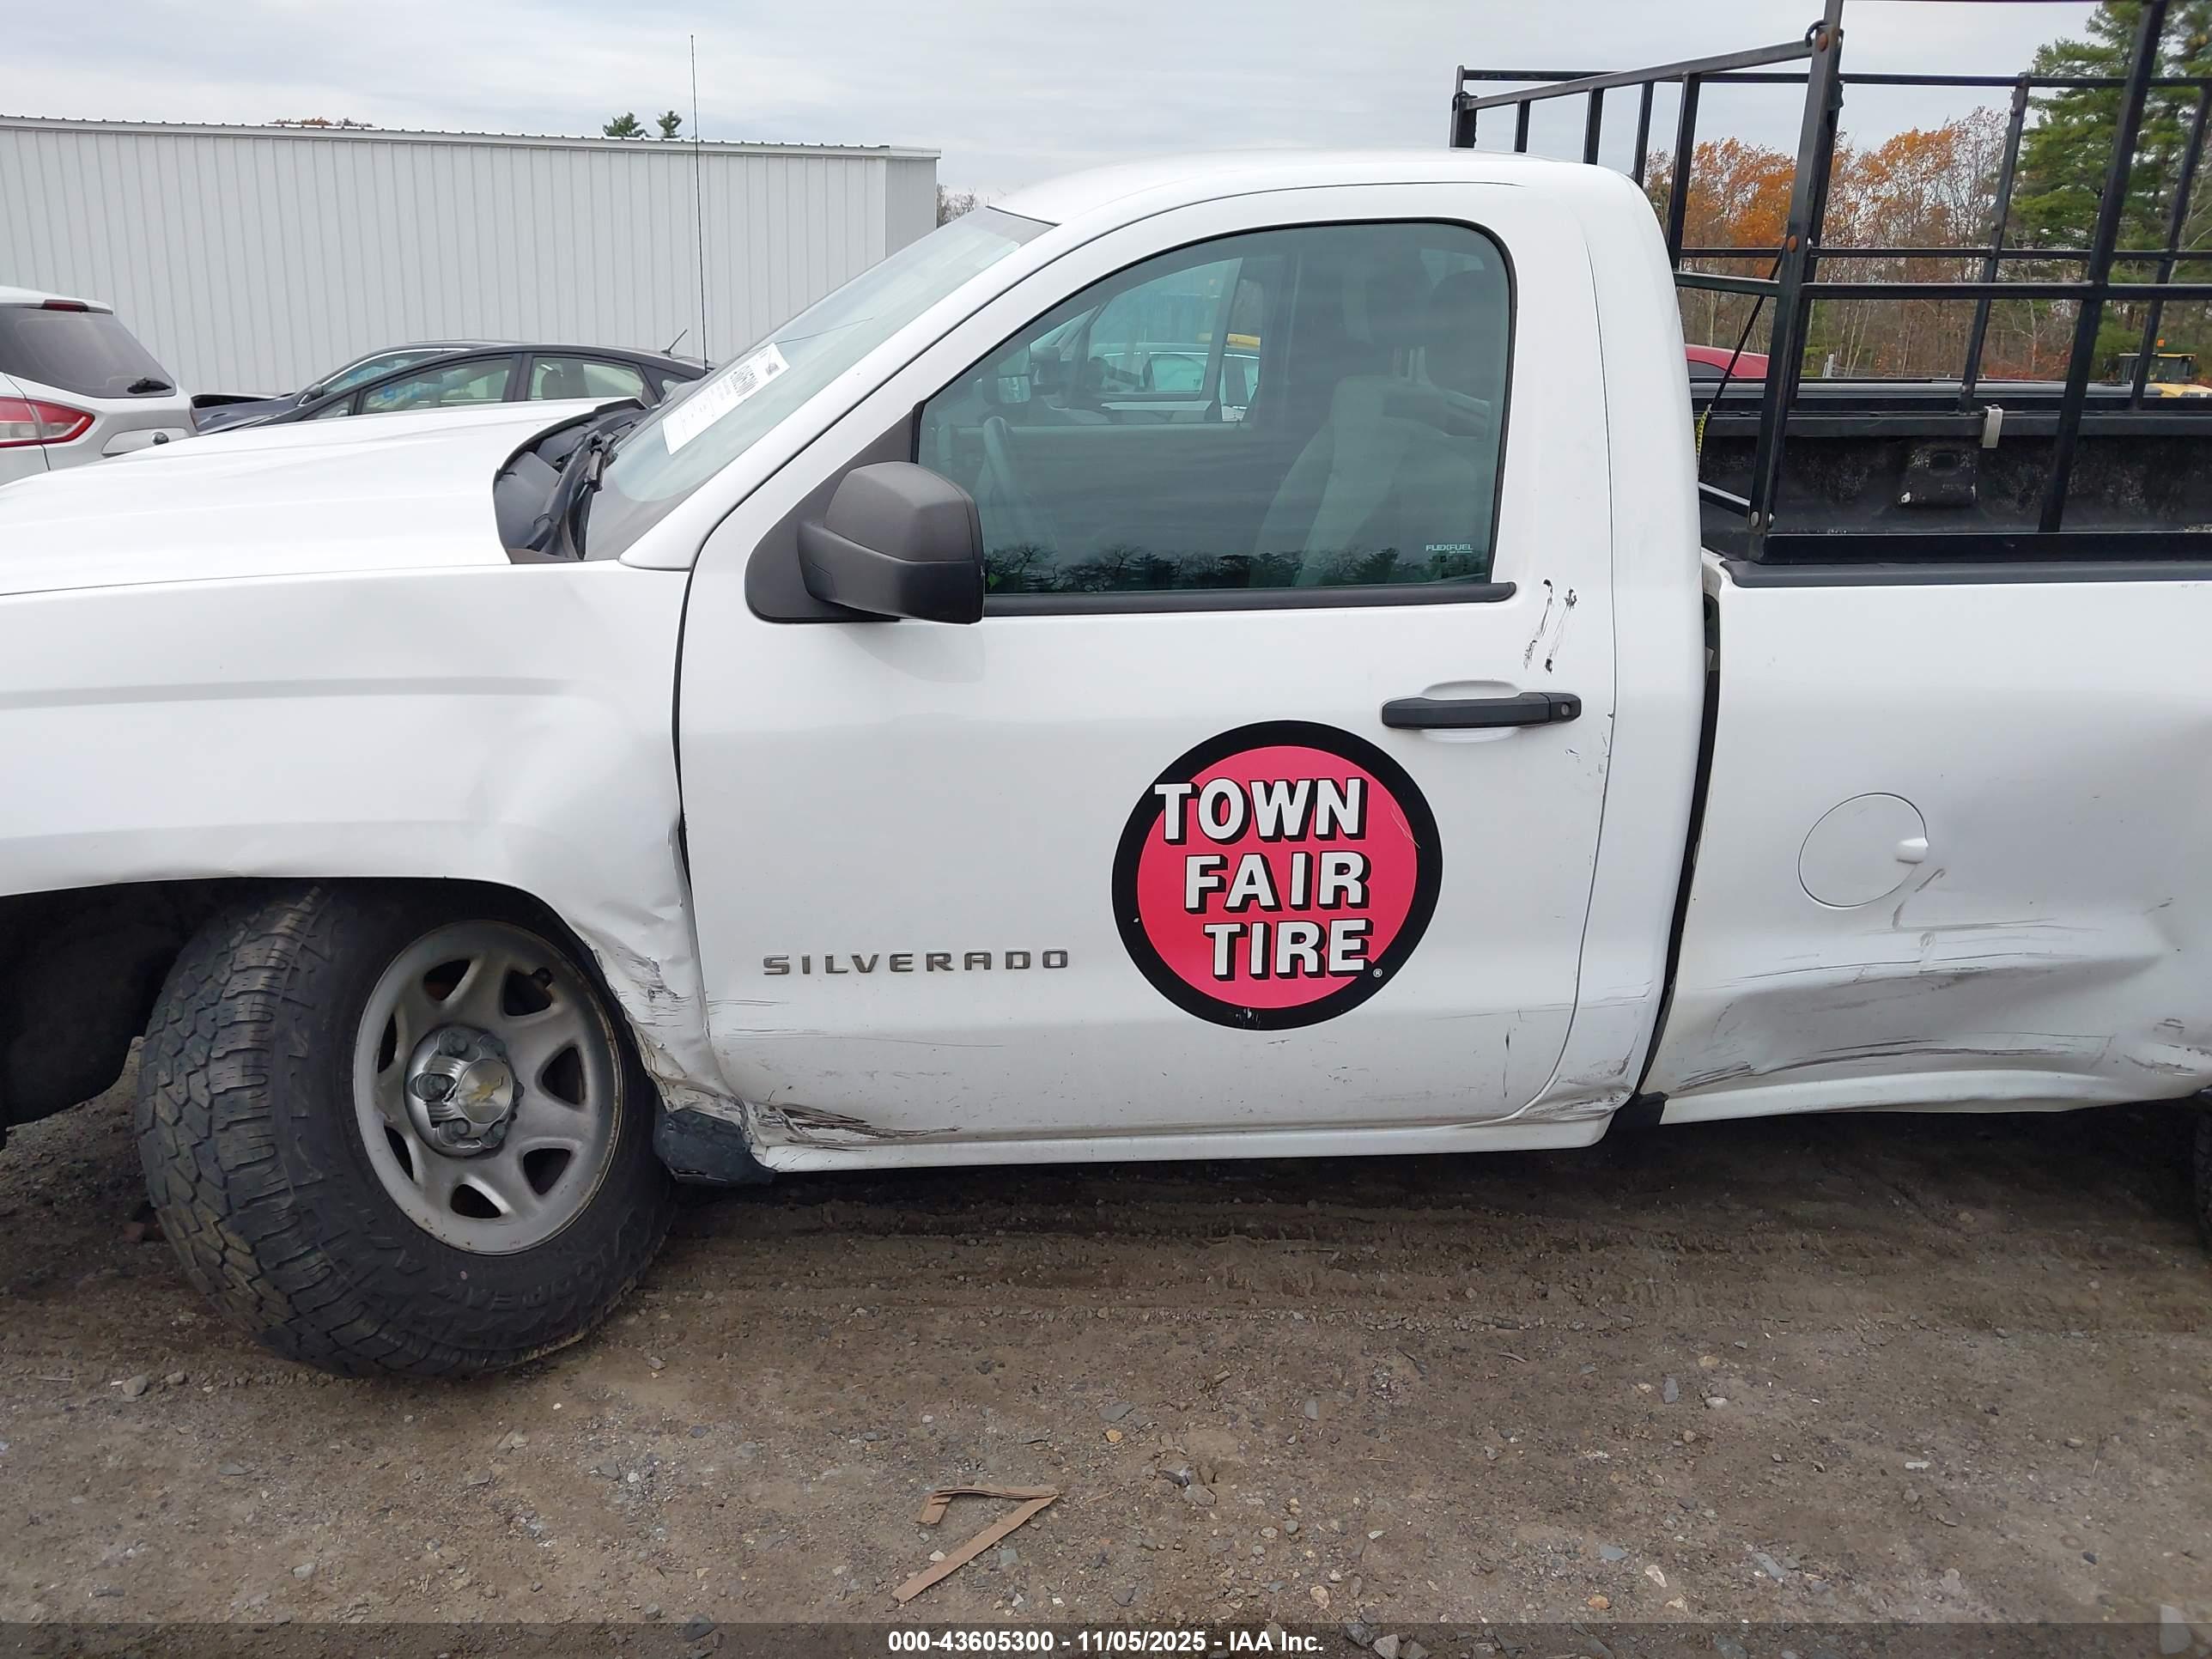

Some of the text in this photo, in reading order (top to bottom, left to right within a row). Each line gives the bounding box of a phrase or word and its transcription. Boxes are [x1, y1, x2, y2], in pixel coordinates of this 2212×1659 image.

[1154, 778, 1361, 841] TOWN
[1185, 852, 1364, 909] FAIR
[763, 948, 1069, 975] SILVERADO
[1204, 920, 1367, 976] TIRE
